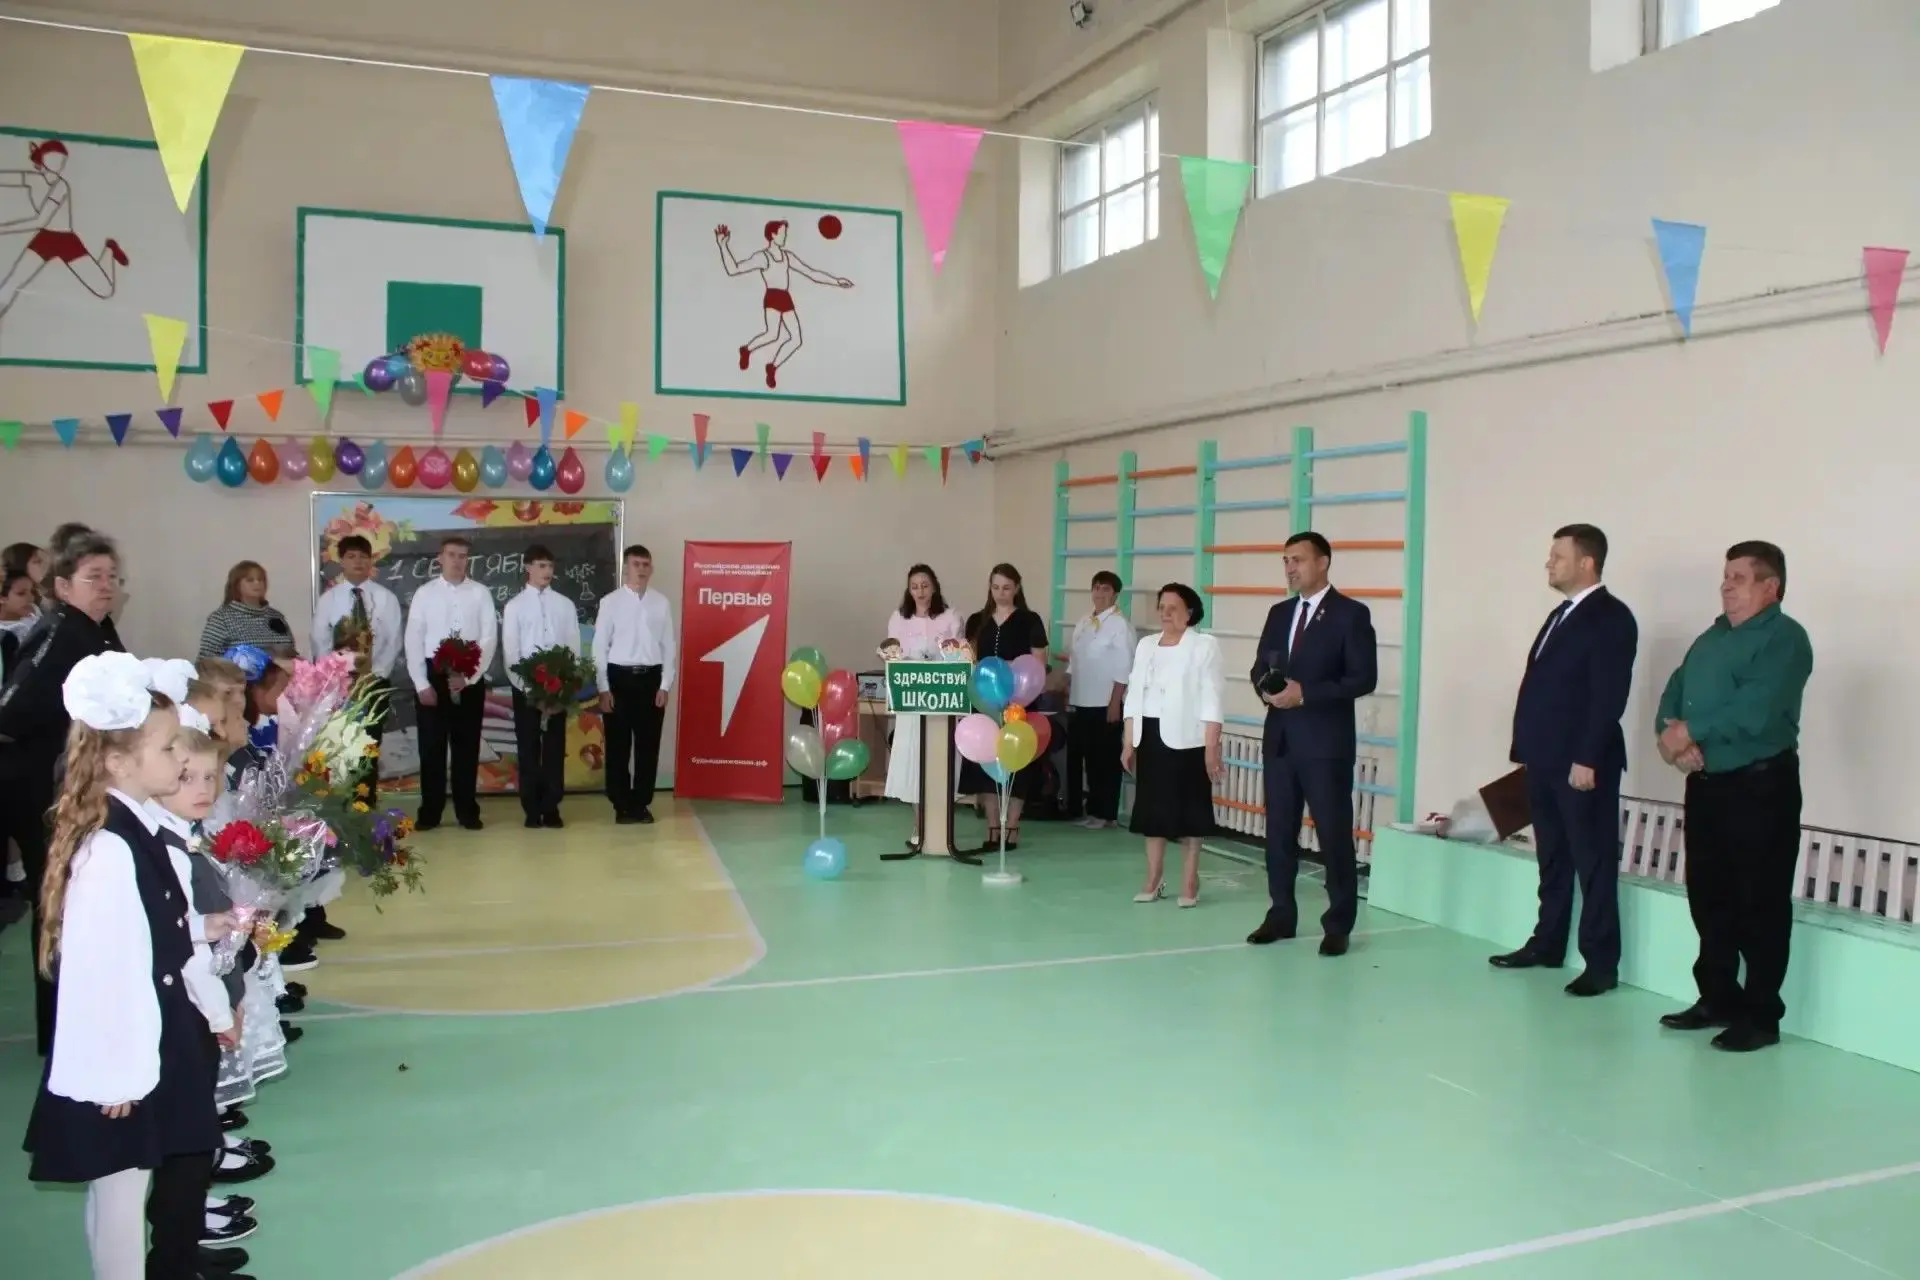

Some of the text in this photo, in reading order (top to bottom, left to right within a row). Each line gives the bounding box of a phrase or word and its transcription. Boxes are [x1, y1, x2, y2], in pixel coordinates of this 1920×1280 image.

[387, 559, 403, 580] 1
[698, 587, 773, 611] Первые
[893, 671, 967, 687] ЗДРАВСТВУЙ
[901, 691, 964, 710] ШКОЛА!
